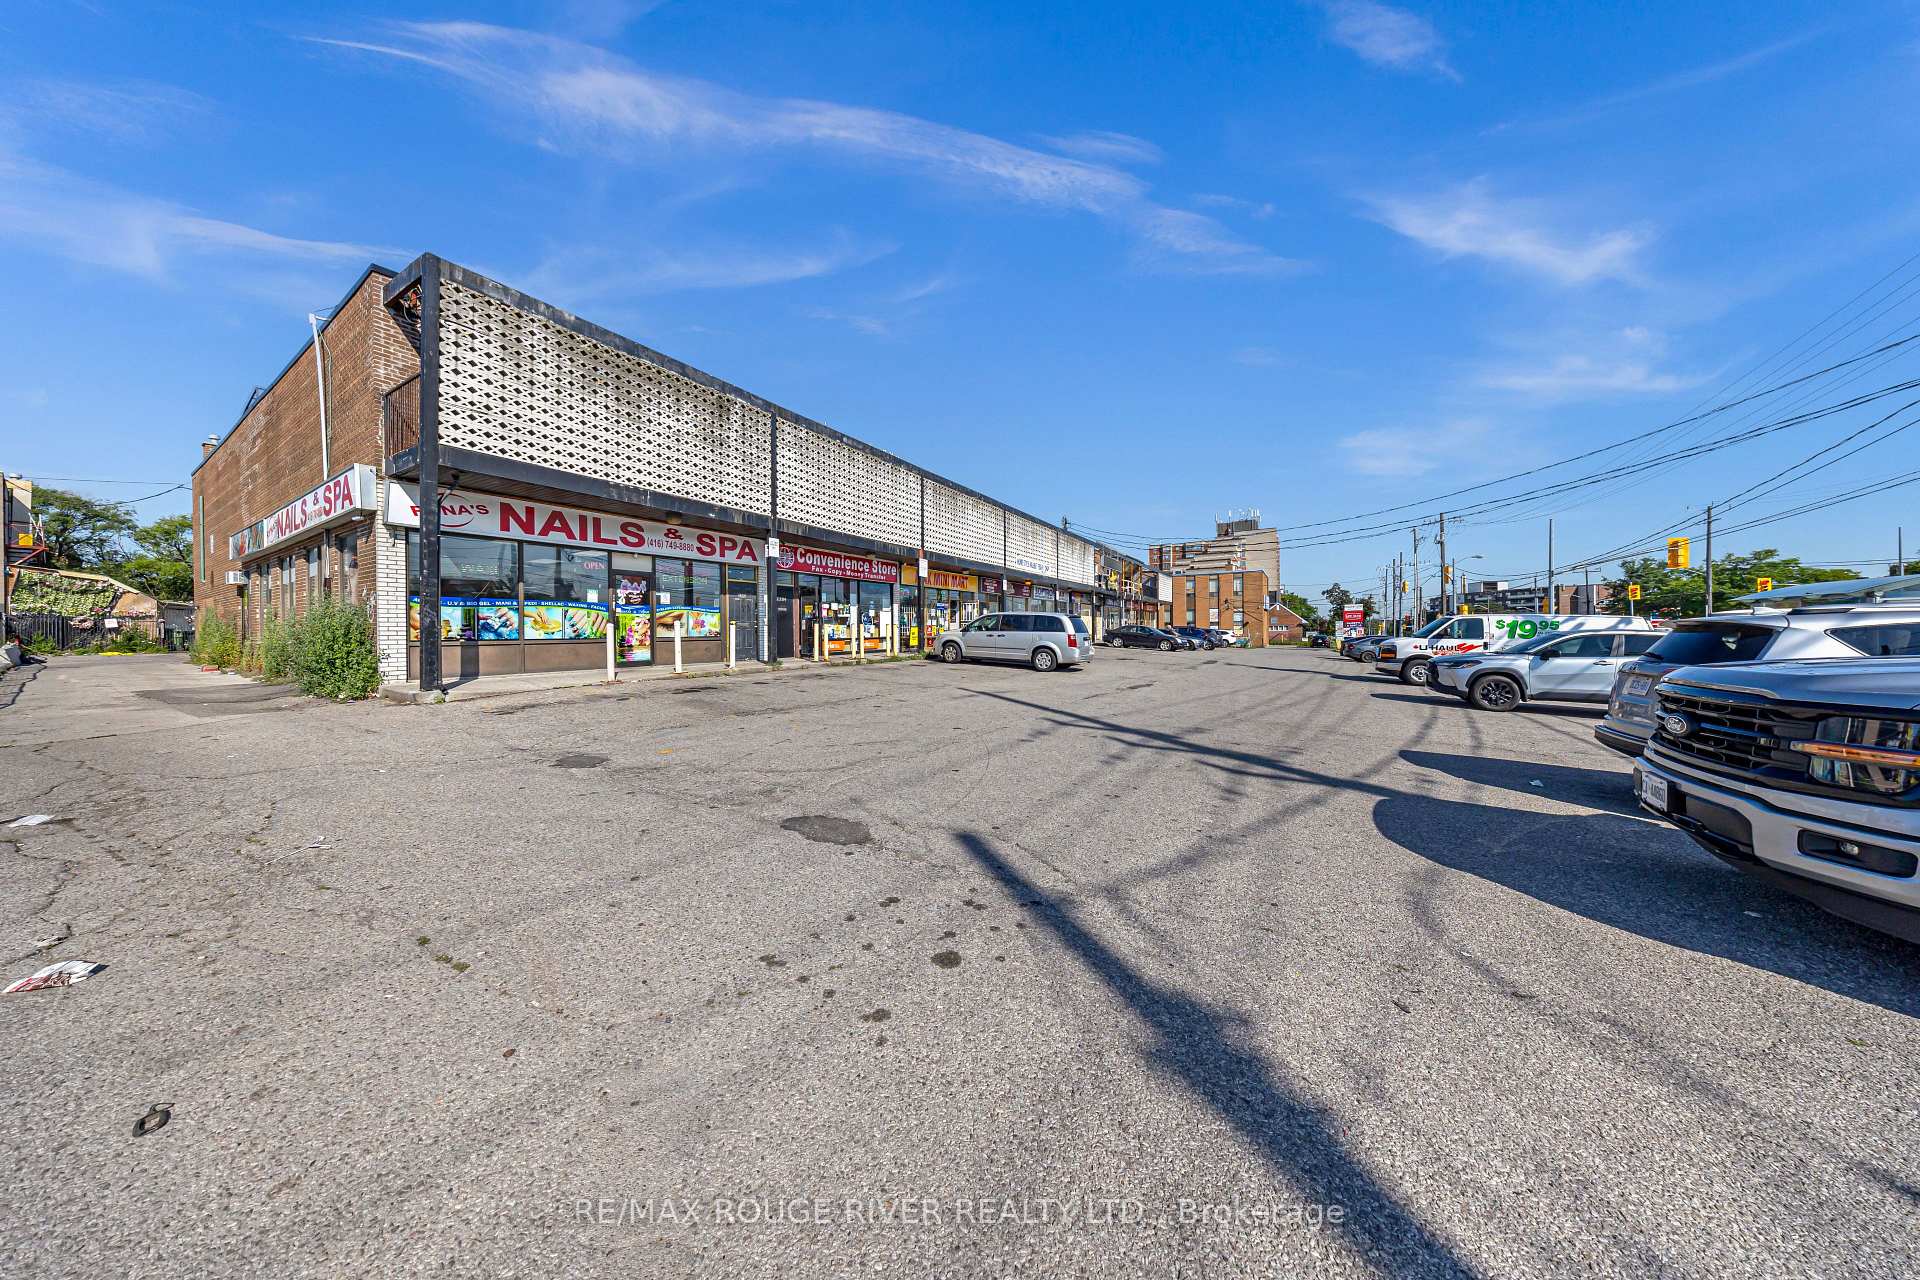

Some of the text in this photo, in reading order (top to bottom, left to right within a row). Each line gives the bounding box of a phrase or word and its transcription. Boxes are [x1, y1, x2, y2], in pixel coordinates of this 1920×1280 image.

[277, 498, 307, 538] NAILS
[313, 491, 320, 506] &
[323, 474, 354, 517] SPA
[500, 501, 646, 548] NAILS
[663, 527, 684, 541] &
[695, 533, 758, 562] SPA
[647, 537, 664, 549] (416)
[584, 561, 605, 570] OPEN
[796, 547, 870, 573] Convenience
[872, 557, 897, 576] Store
[812, 565, 823, 573] Fax
[827, 567, 842, 577] Copy
[951, 574, 968, 590] MART
[1419, 644, 1460, 652] U-HAUL
